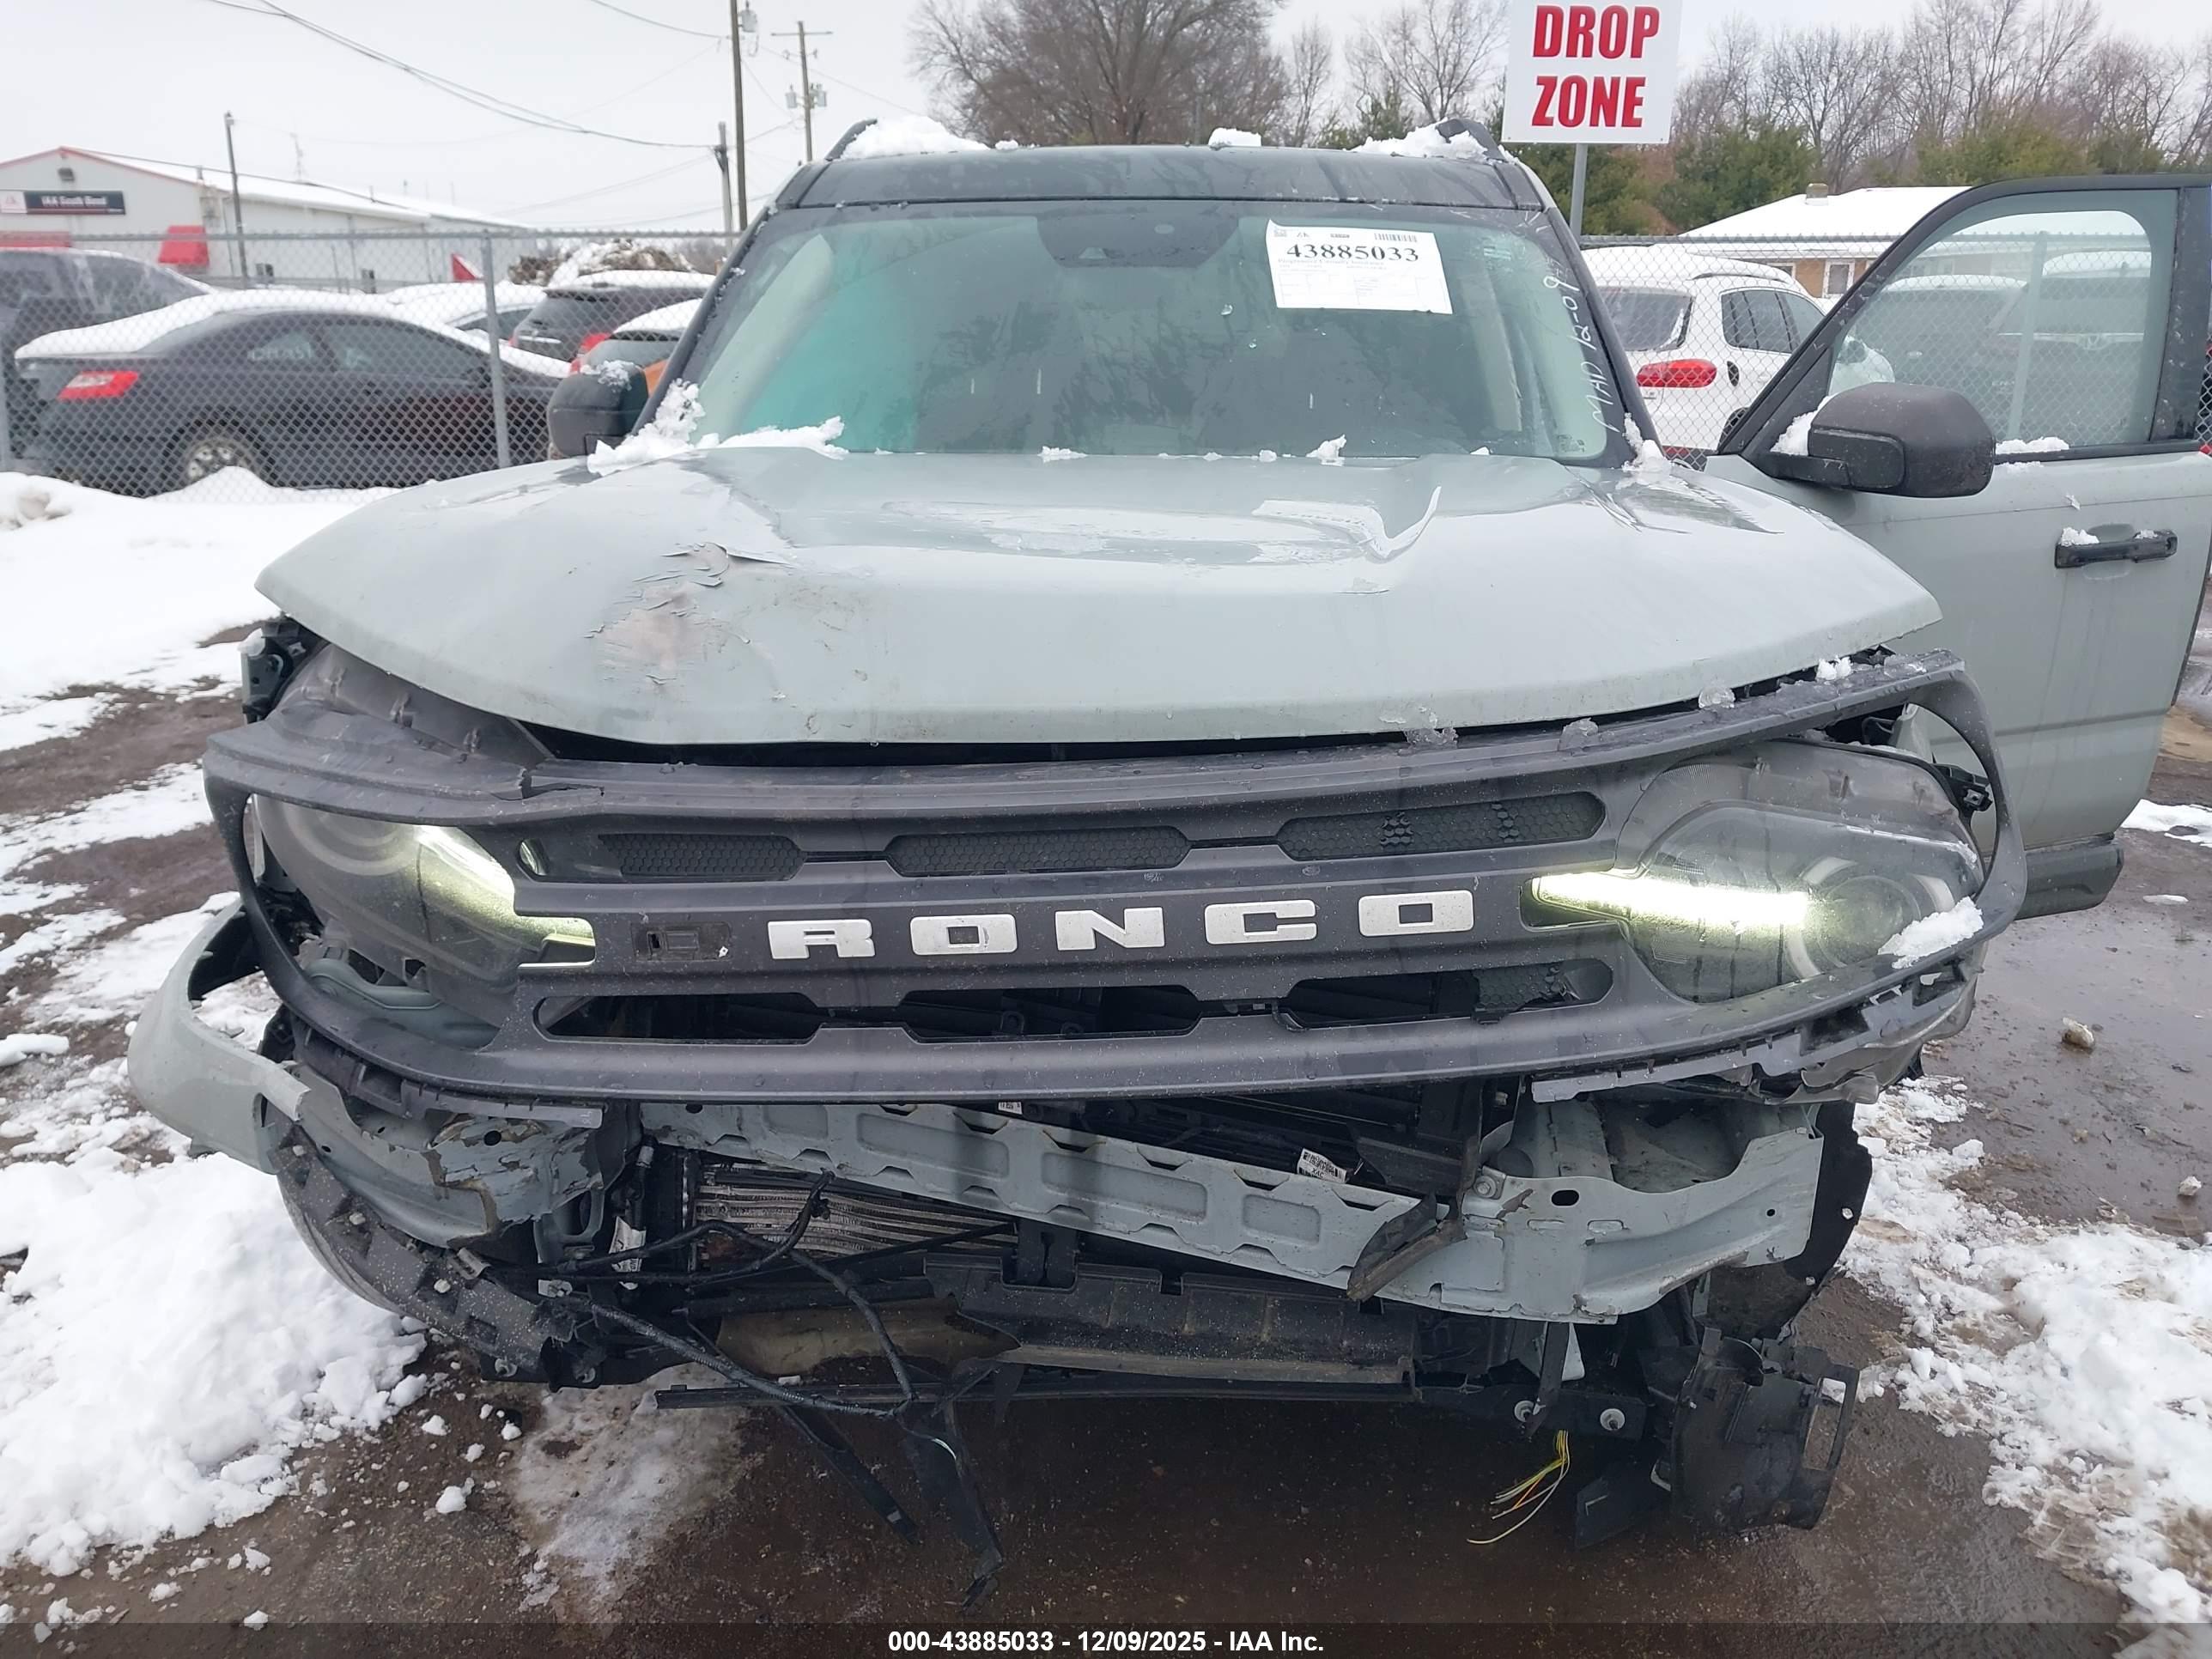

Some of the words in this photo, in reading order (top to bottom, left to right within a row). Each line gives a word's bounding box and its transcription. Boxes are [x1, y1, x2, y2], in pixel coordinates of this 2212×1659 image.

[1533, 5, 1660, 59] DROP
[1531, 76, 1646, 128] ZONE
[1287, 244, 1419, 262] 43885033
[768, 890, 1474, 959] RONCO
